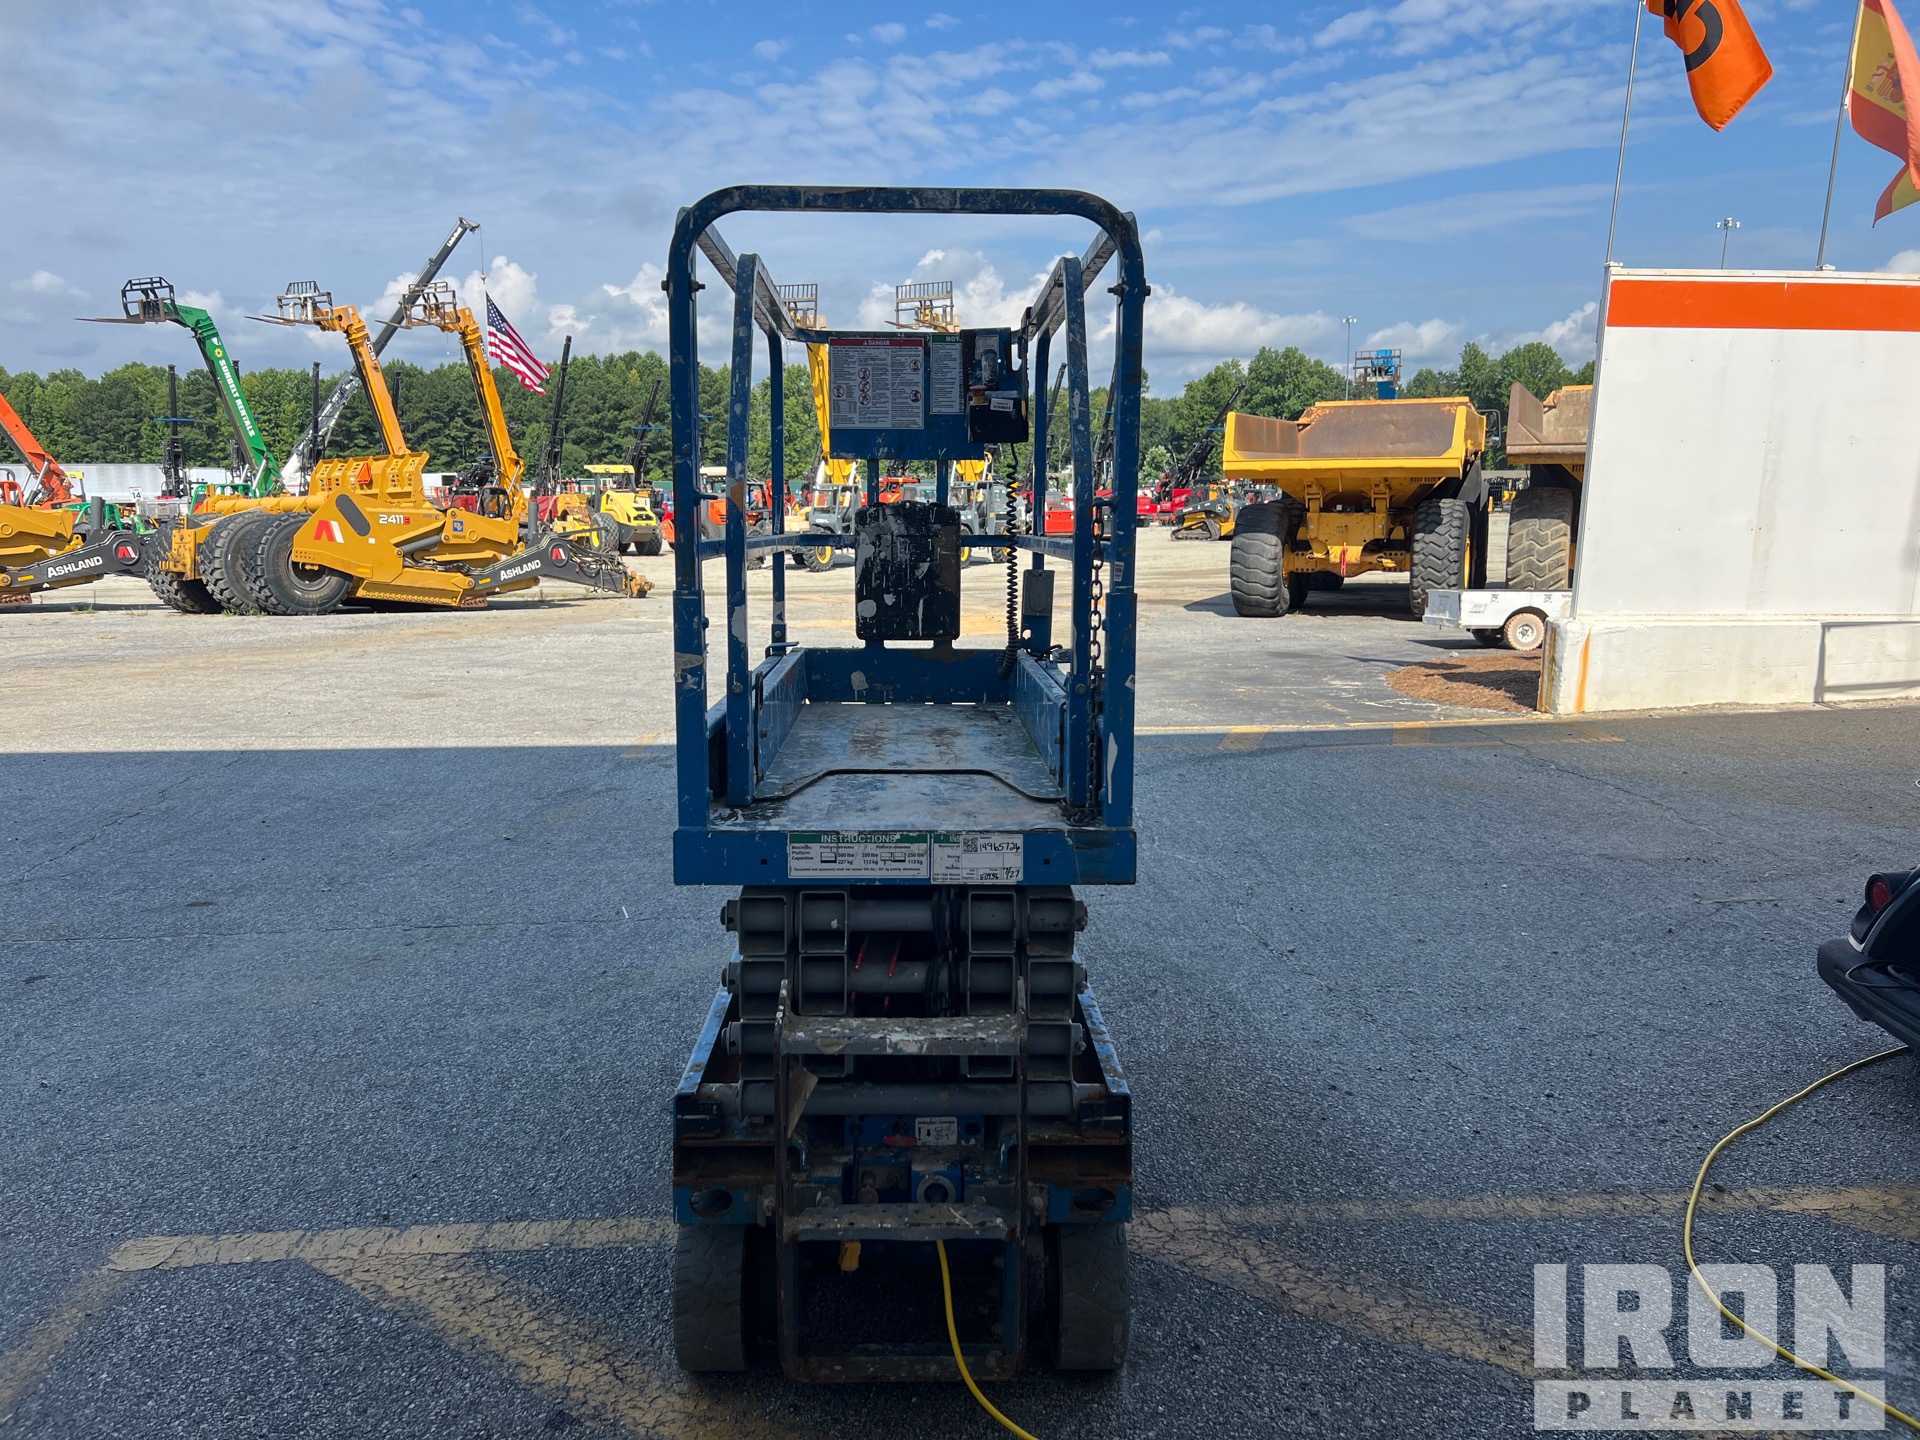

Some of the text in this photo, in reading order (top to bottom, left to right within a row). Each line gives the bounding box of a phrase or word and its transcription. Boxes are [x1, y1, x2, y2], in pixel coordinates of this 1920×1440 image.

[365, 337, 377, 361] JCB
[218, 359, 256, 437] SUNBELT RENTALS
[132, 491, 141, 499] 14
[379, 513, 411, 525] 2411E
[47, 556, 103, 579] ASHLAND
[499, 558, 542, 581] ASHLAND
[821, 834, 897, 843] INSTRUCTIONS
